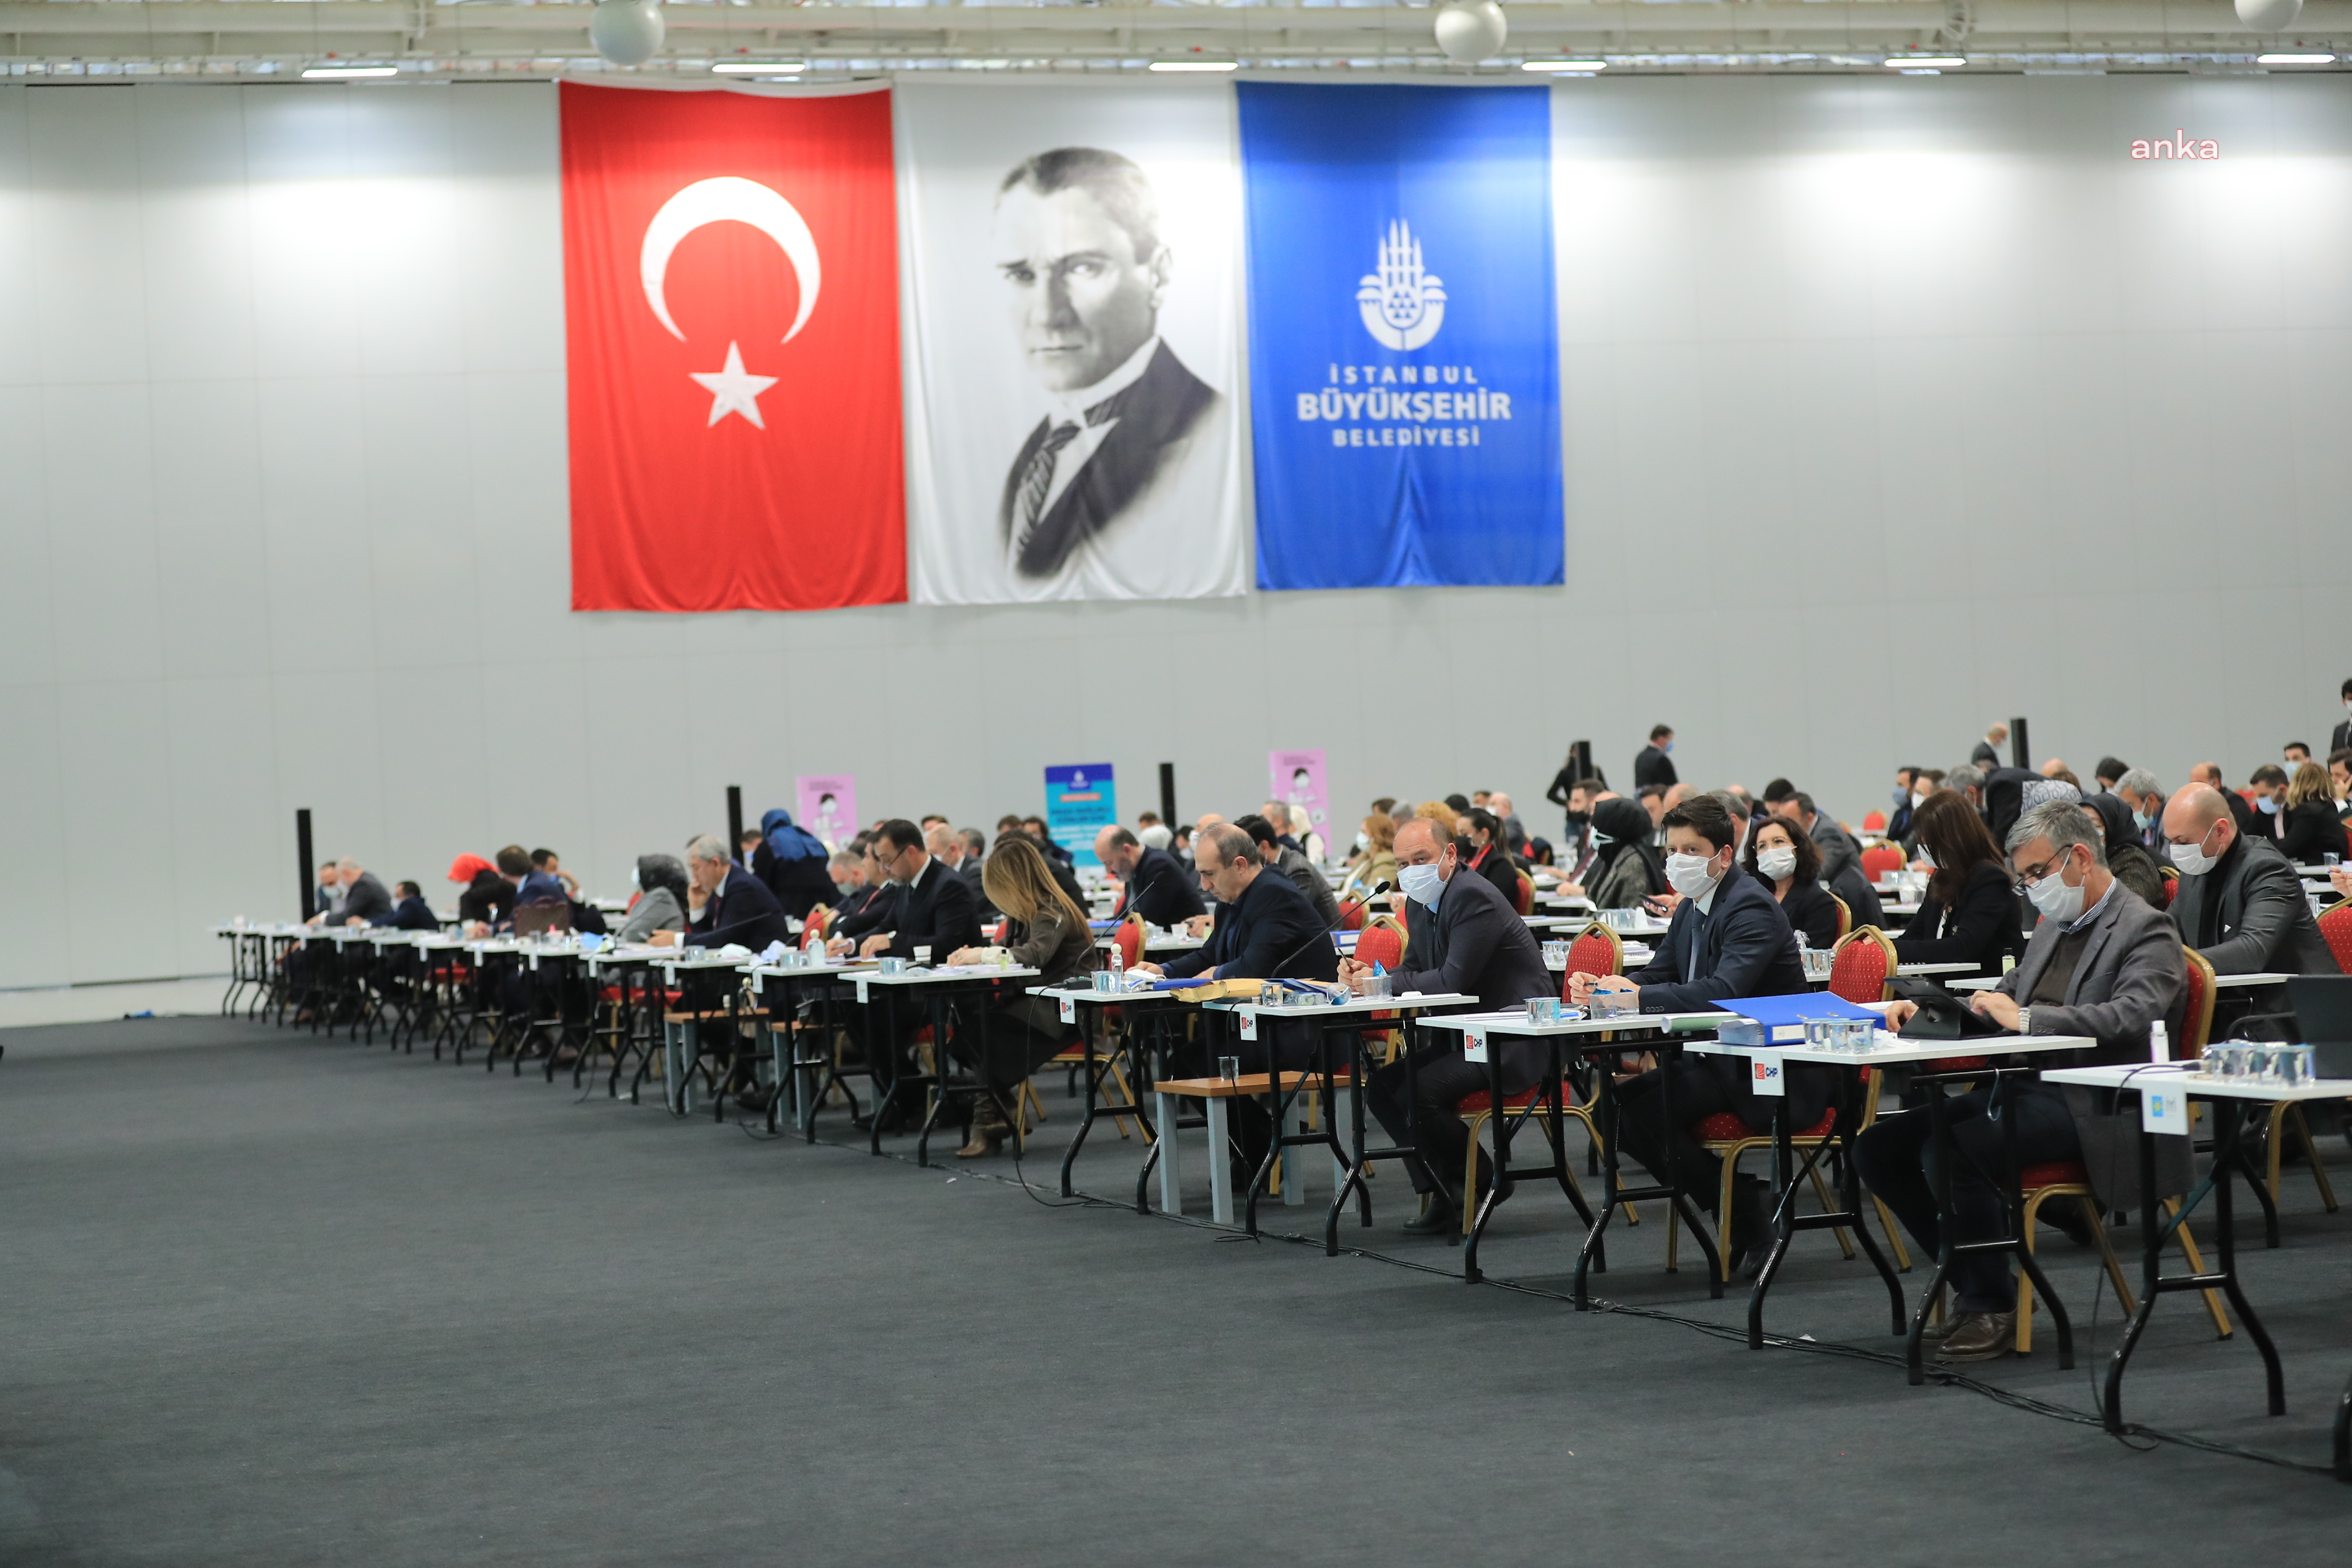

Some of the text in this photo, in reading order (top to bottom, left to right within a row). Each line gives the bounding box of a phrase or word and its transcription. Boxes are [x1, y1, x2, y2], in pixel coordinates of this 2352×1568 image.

[1329, 362, 1478, 385] İSTANBUL
[1297, 387, 1513, 423] BÜYÜKŞEHİR
[1331, 424, 1481, 447] BELEDİYESİ
[1474, 1038, 1482, 1047] CHP
[1766, 1067, 1778, 1077] CHP
